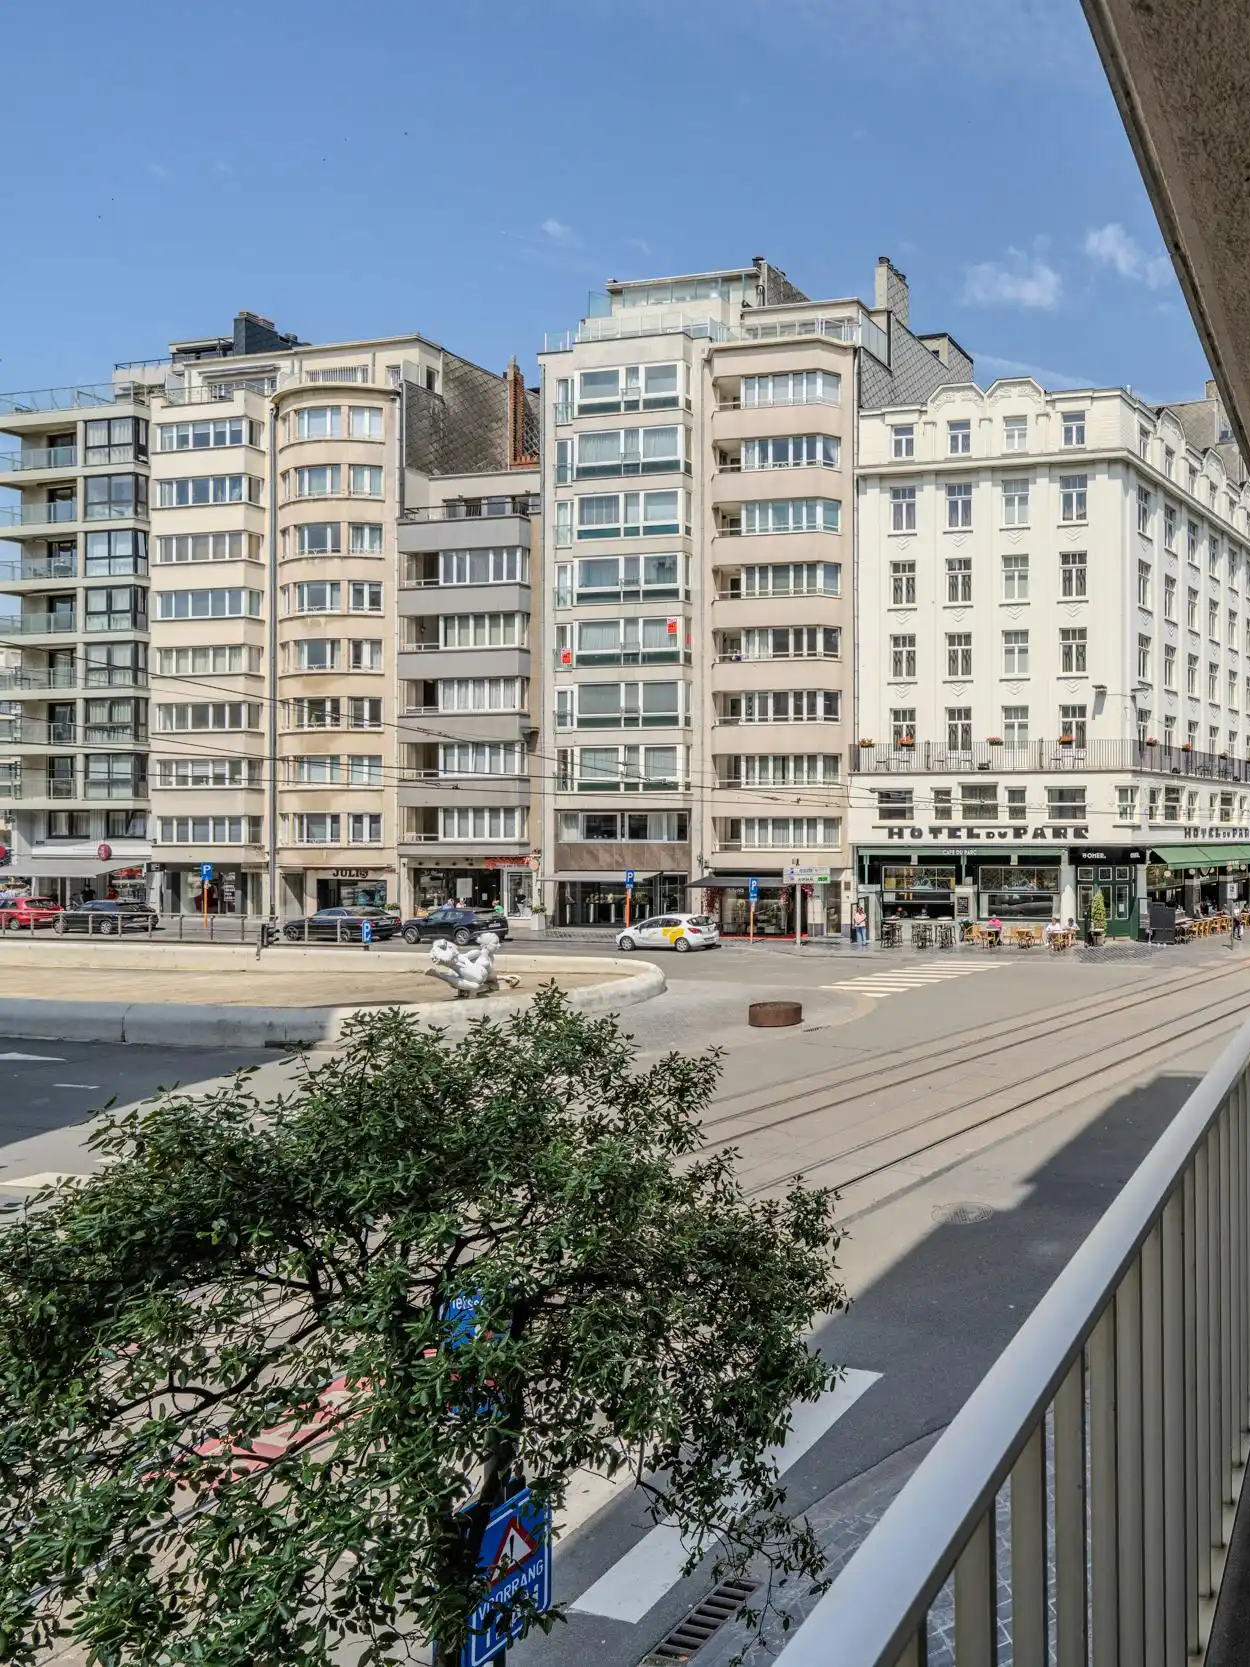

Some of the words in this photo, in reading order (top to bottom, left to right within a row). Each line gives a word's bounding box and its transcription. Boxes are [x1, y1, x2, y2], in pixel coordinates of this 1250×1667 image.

[887, 827, 981, 839] HOTEL
[985, 831, 1008, 839] DU
[1013, 827, 1089, 839] PARC
[1184, 826, 1220, 839] HOTEL
[203, 864, 211, 875] P
